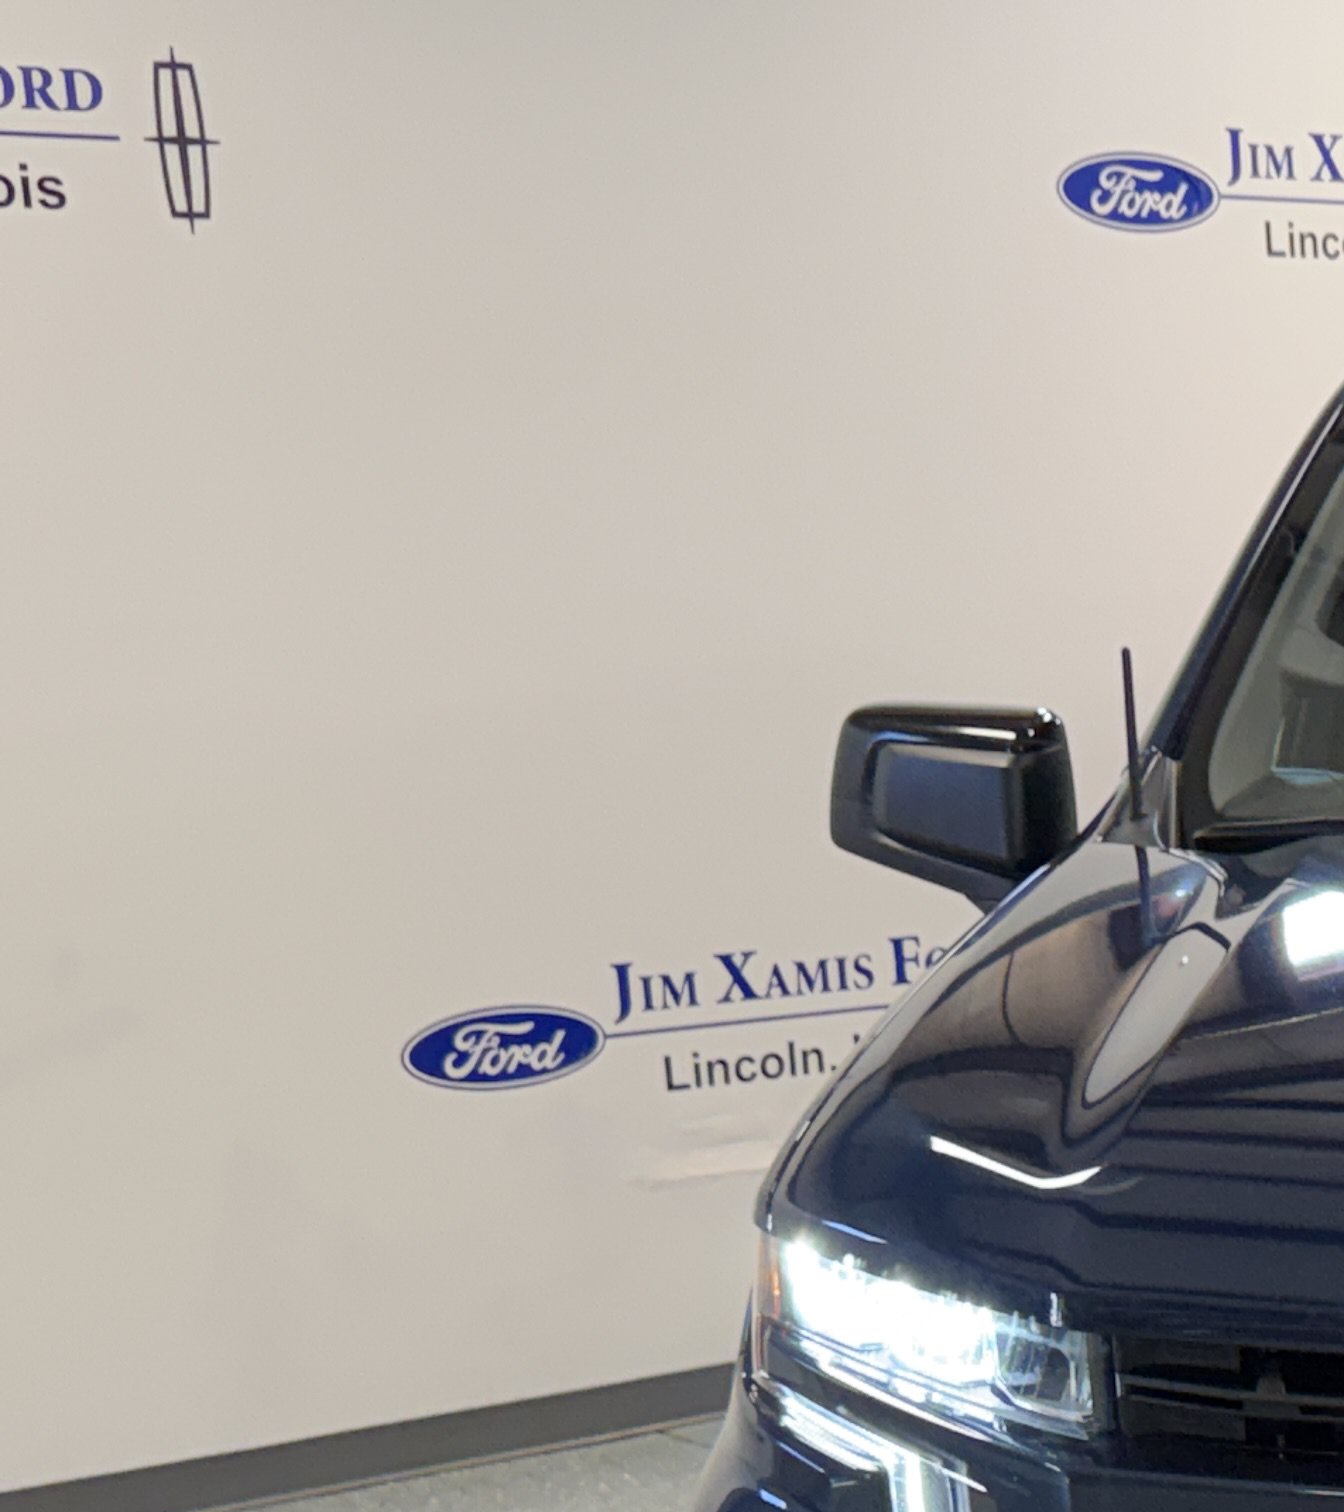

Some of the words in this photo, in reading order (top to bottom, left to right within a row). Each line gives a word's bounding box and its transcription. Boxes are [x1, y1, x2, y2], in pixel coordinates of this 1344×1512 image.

[1225, 127, 1297, 187] JIM
[1088, 163, 1188, 221] Ford
[610, 961, 700, 1024] JIM
[712, 950, 874, 1004] XAMIS
[443, 1020, 566, 1080] Ford
